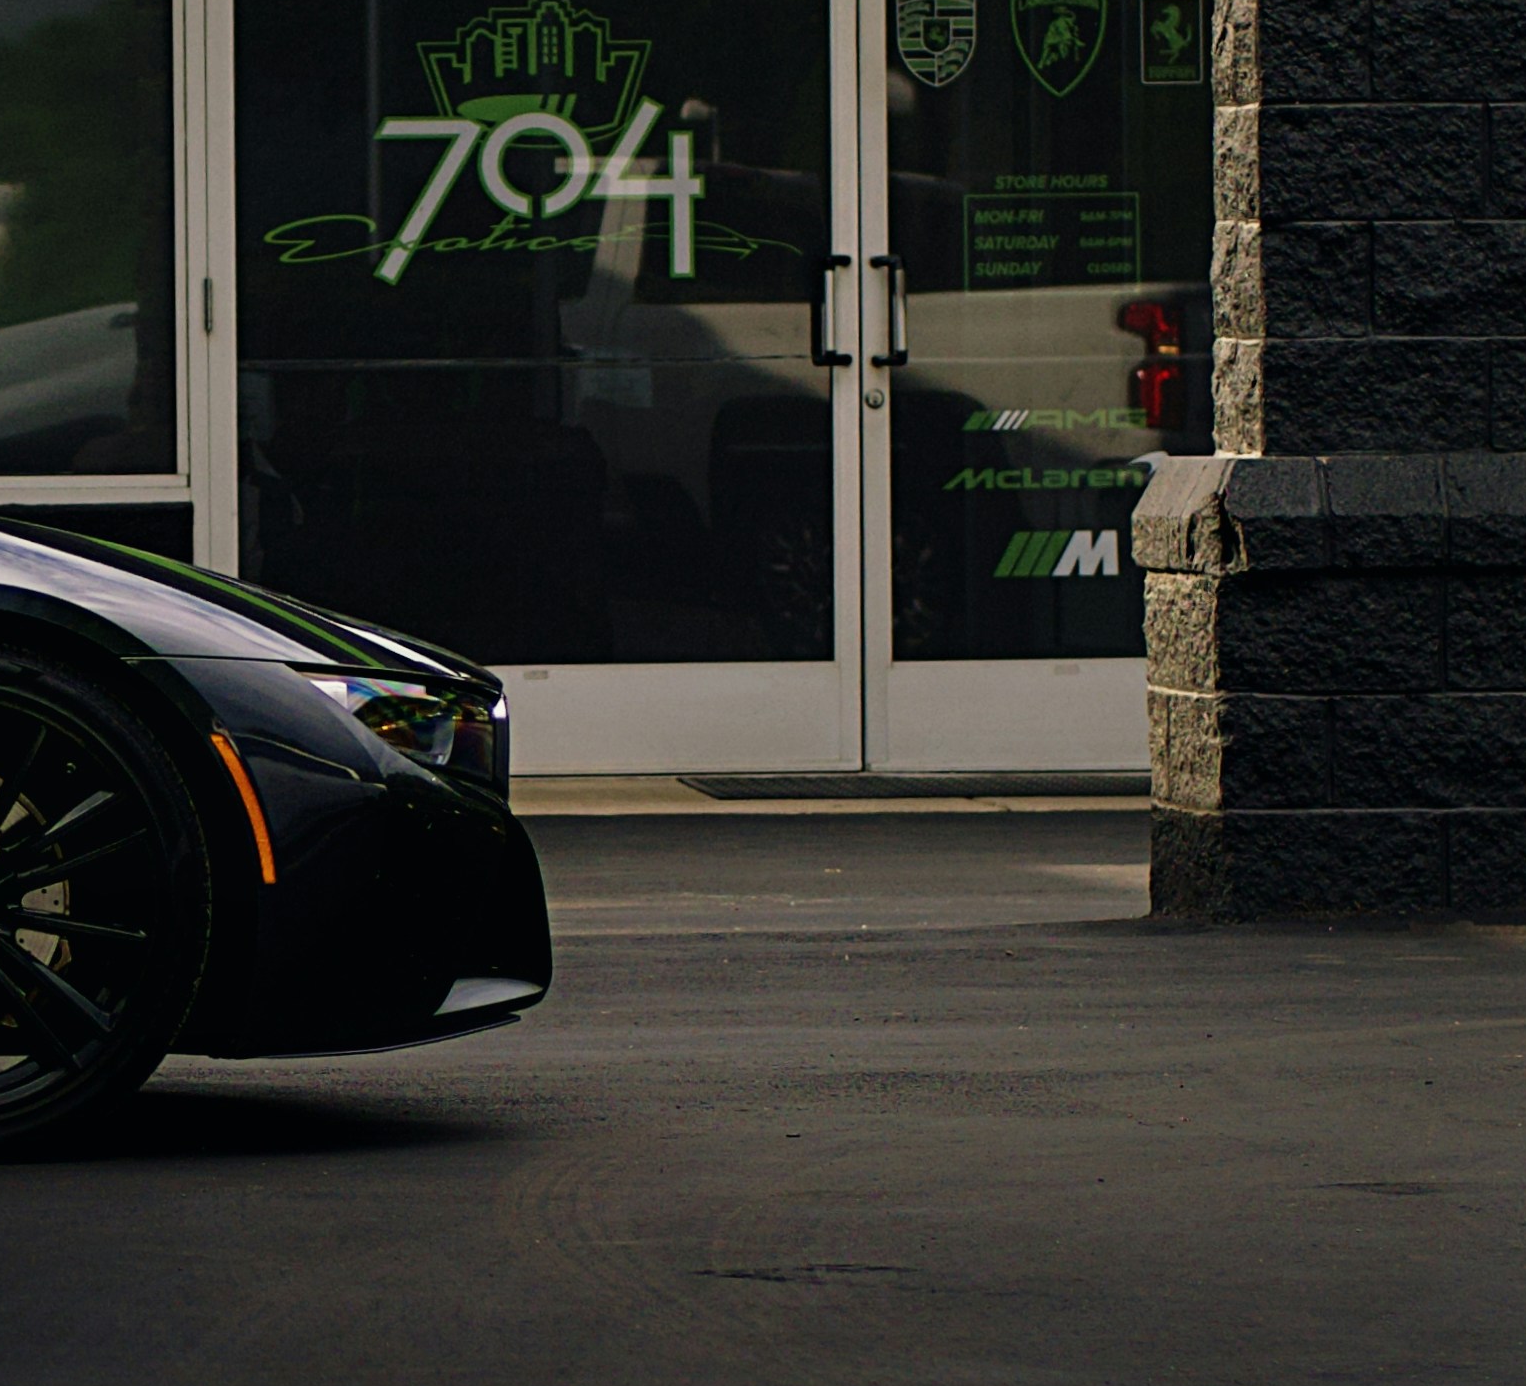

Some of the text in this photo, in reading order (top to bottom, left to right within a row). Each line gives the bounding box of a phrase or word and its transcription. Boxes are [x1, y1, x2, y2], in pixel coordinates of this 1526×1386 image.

[372, 95, 706, 286] 704
[994, 173, 1109, 190] STORE HOURS
[974, 234, 1061, 250] SATURDAY
[975, 260, 1043, 277] SUNDAY
[1019, 407, 1148, 430] AMG
[941, 466, 1144, 491] McLaren
